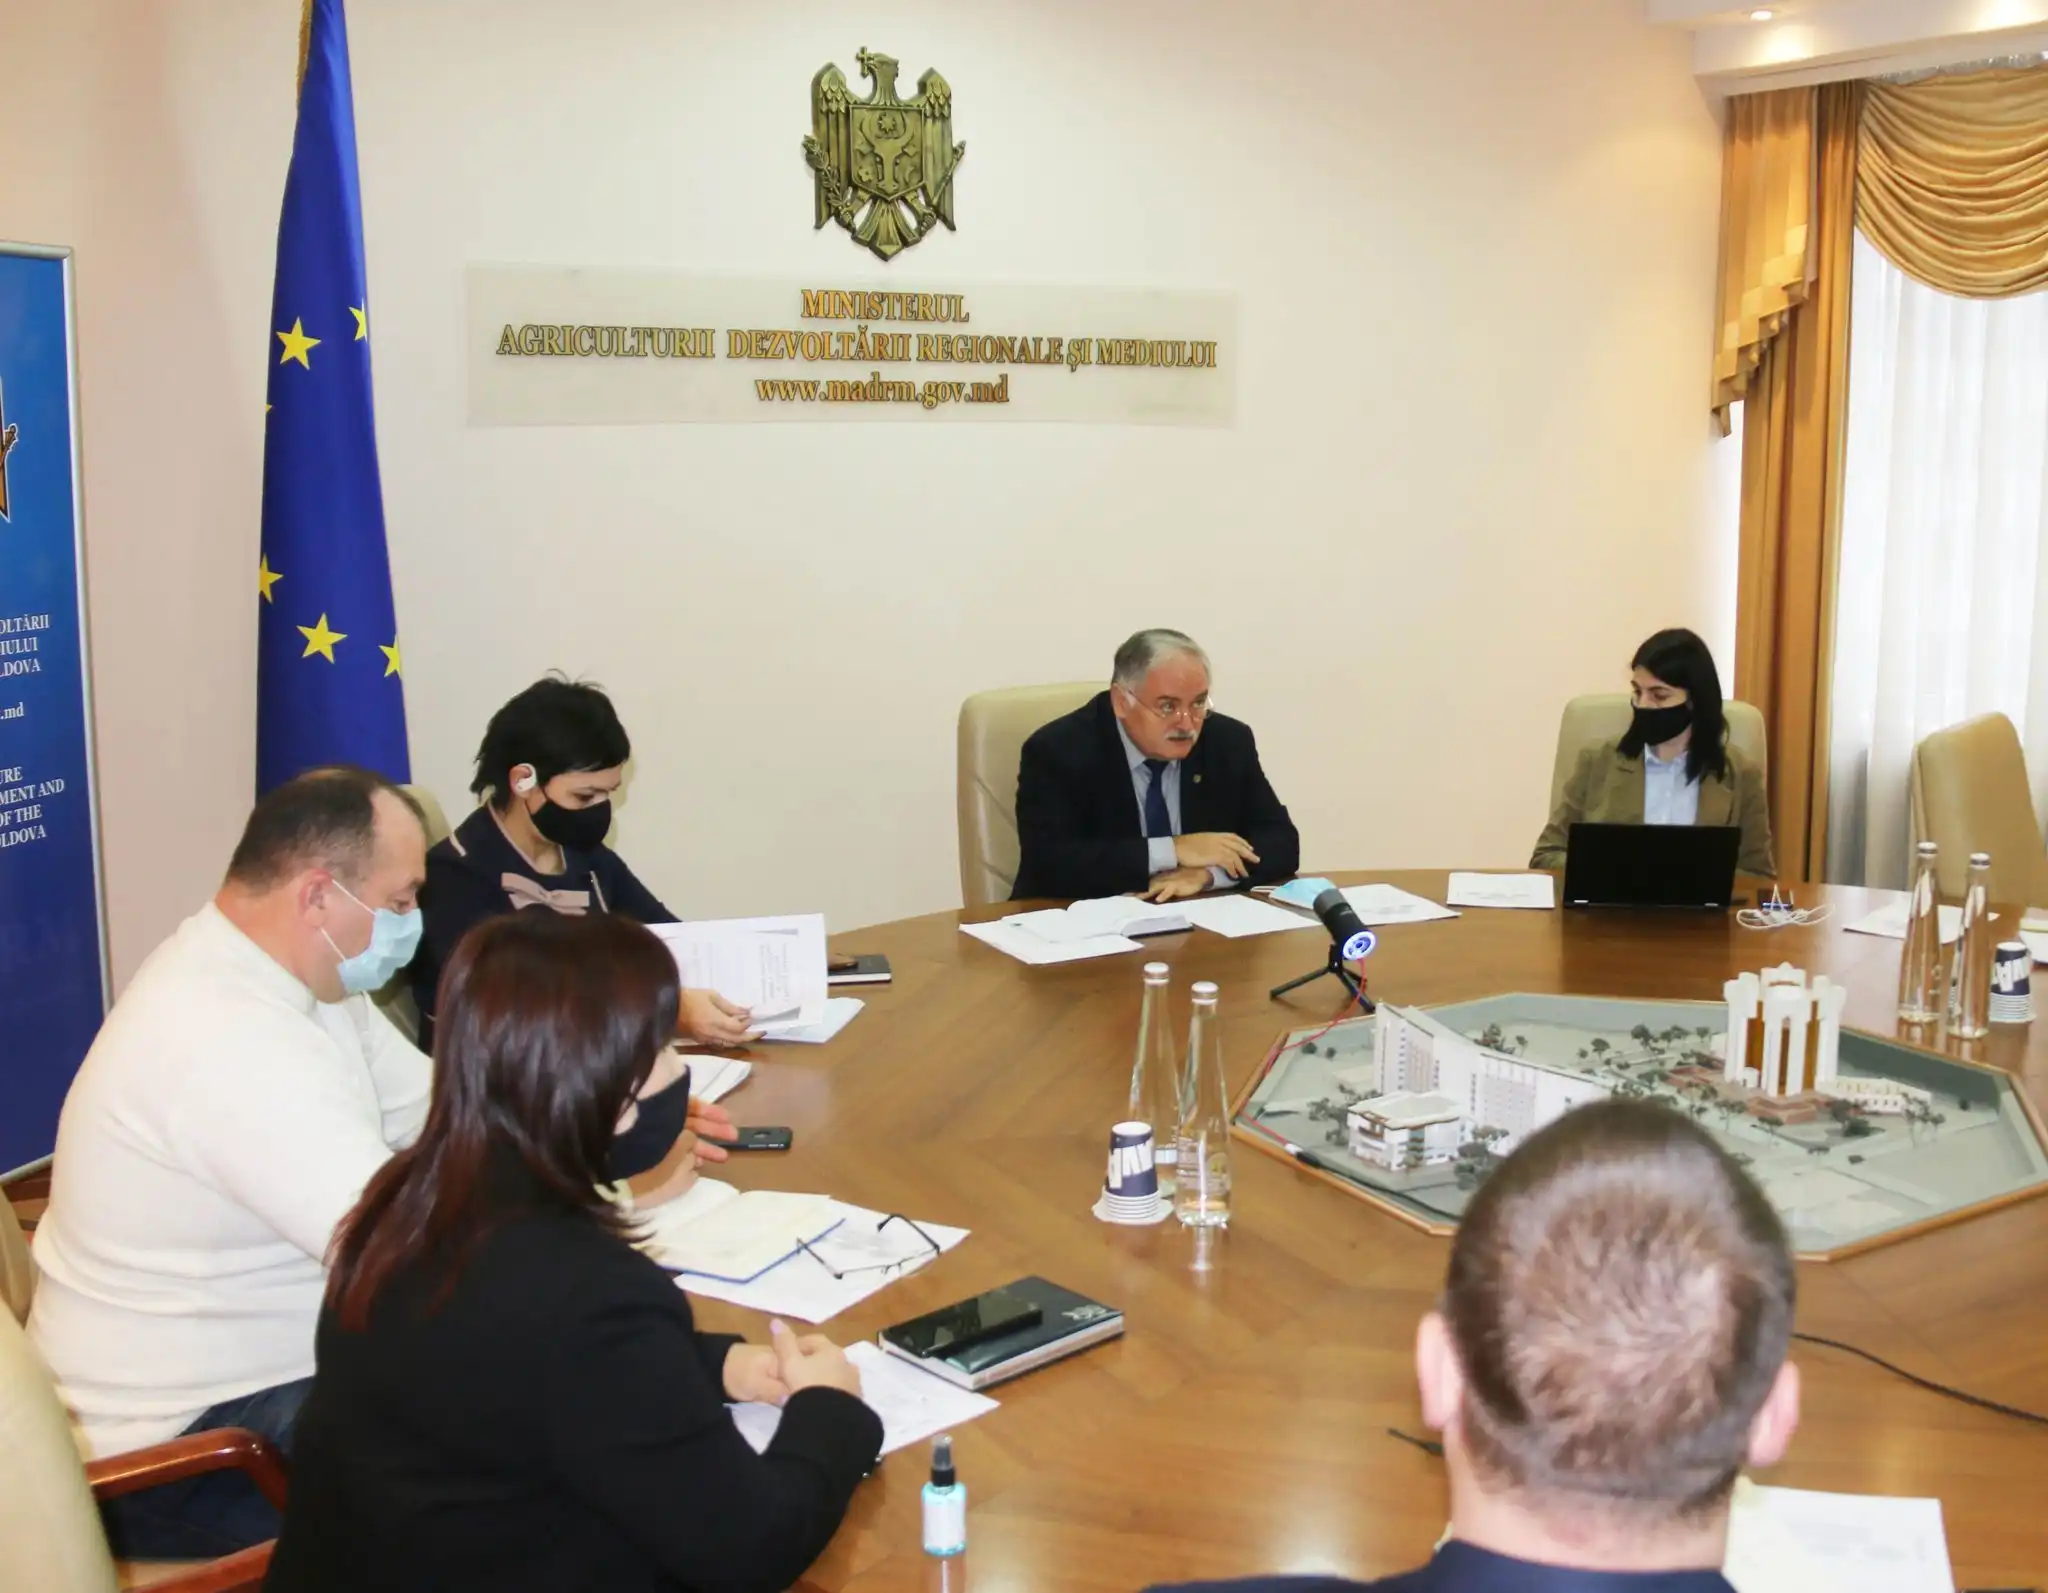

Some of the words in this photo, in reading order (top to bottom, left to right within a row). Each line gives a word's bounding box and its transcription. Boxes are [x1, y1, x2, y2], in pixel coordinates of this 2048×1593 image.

[801, 289, 969, 322] MINISTERUL
[496, 324, 715, 358] AGRICULTURII
[726, 325, 911, 361] DEZVOLTĂRII
[916, 333, 1064, 364] REGIONALE
[1096, 338, 1217, 368] MEDIULUI
[755, 371, 1009, 409] www.madrm.gov.md
[38, 778, 65, 797] AND
[14, 804, 42, 823] THE
[0, 824, 47, 848] LDOVA
